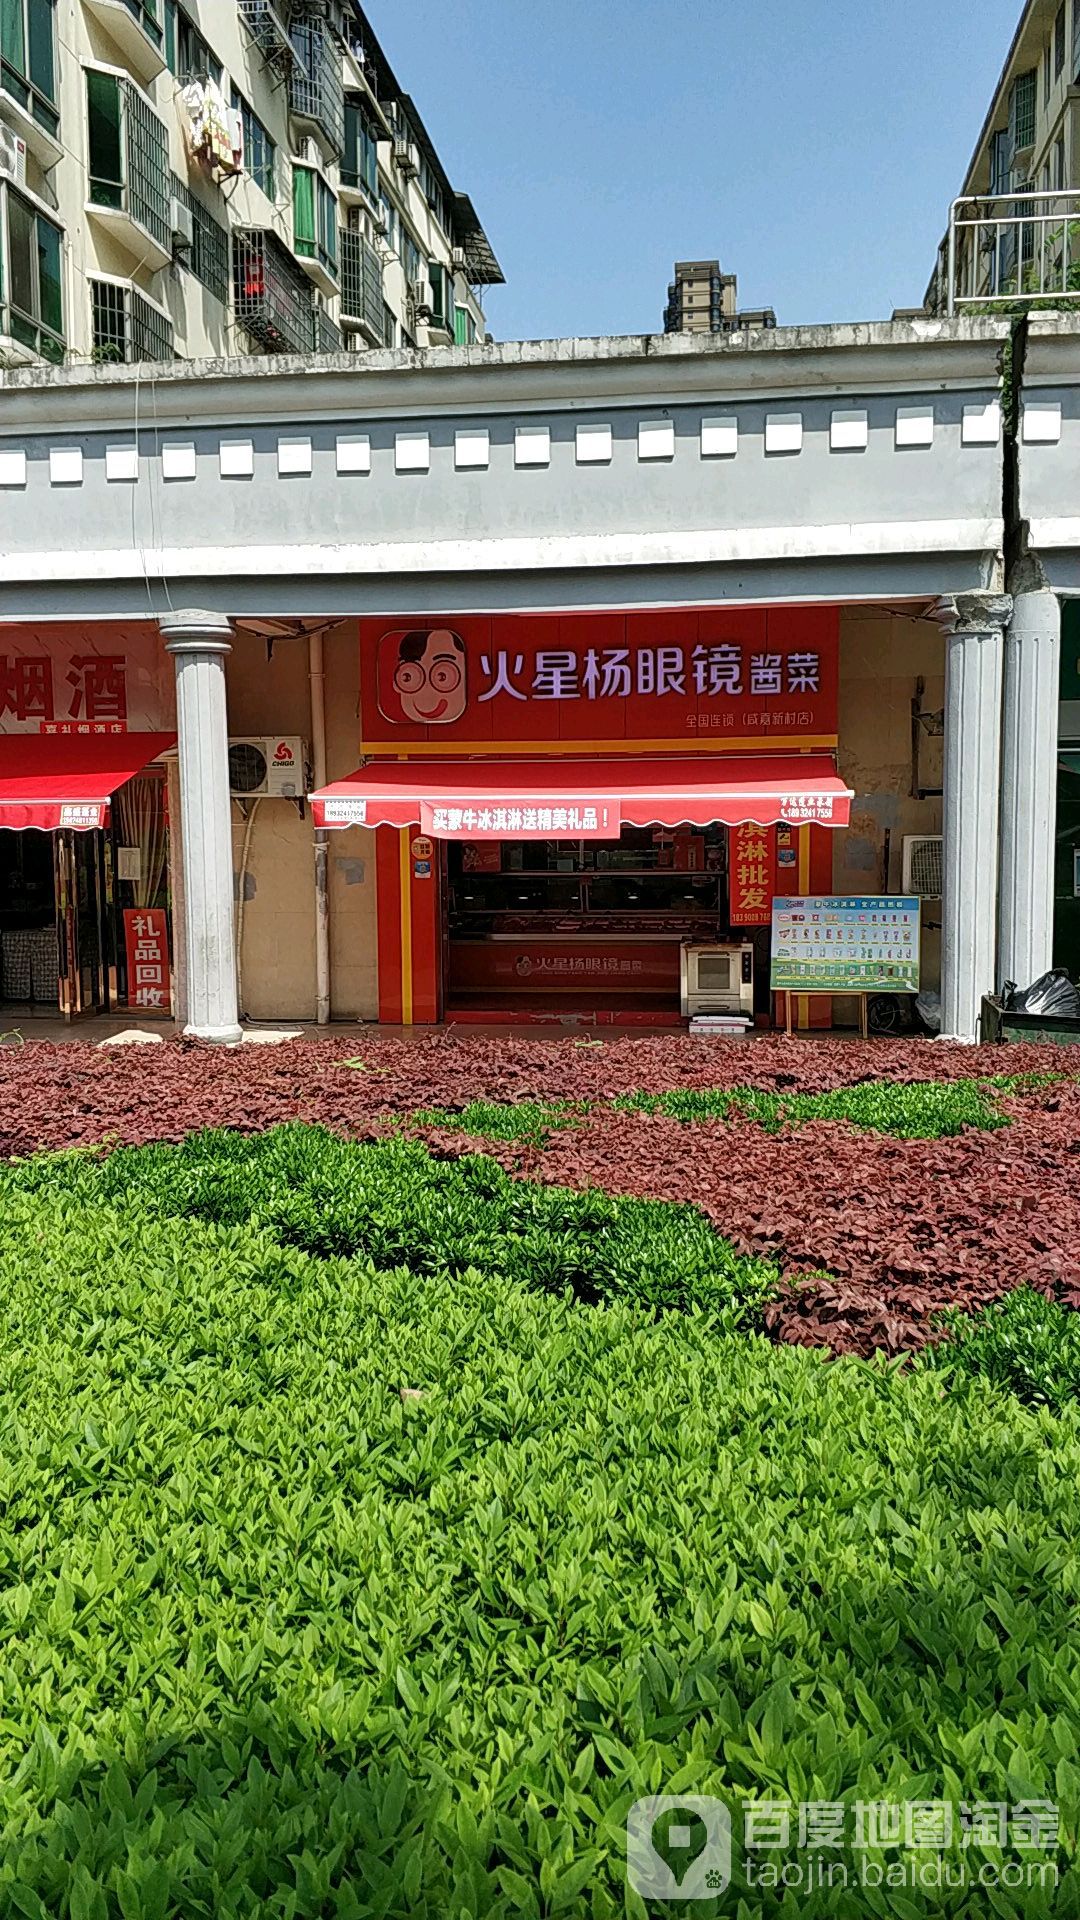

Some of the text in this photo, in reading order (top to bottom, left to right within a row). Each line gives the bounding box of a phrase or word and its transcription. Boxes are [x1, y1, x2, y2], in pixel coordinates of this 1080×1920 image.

[0, 655, 127, 721] 烟酒
[477, 643, 820, 701] 火星杨眼镜酱菜
[432, 807, 608, 831] 买蒙牛冰淇淋送精美礼品！
[131, 915, 164, 1007] 礼品回收
